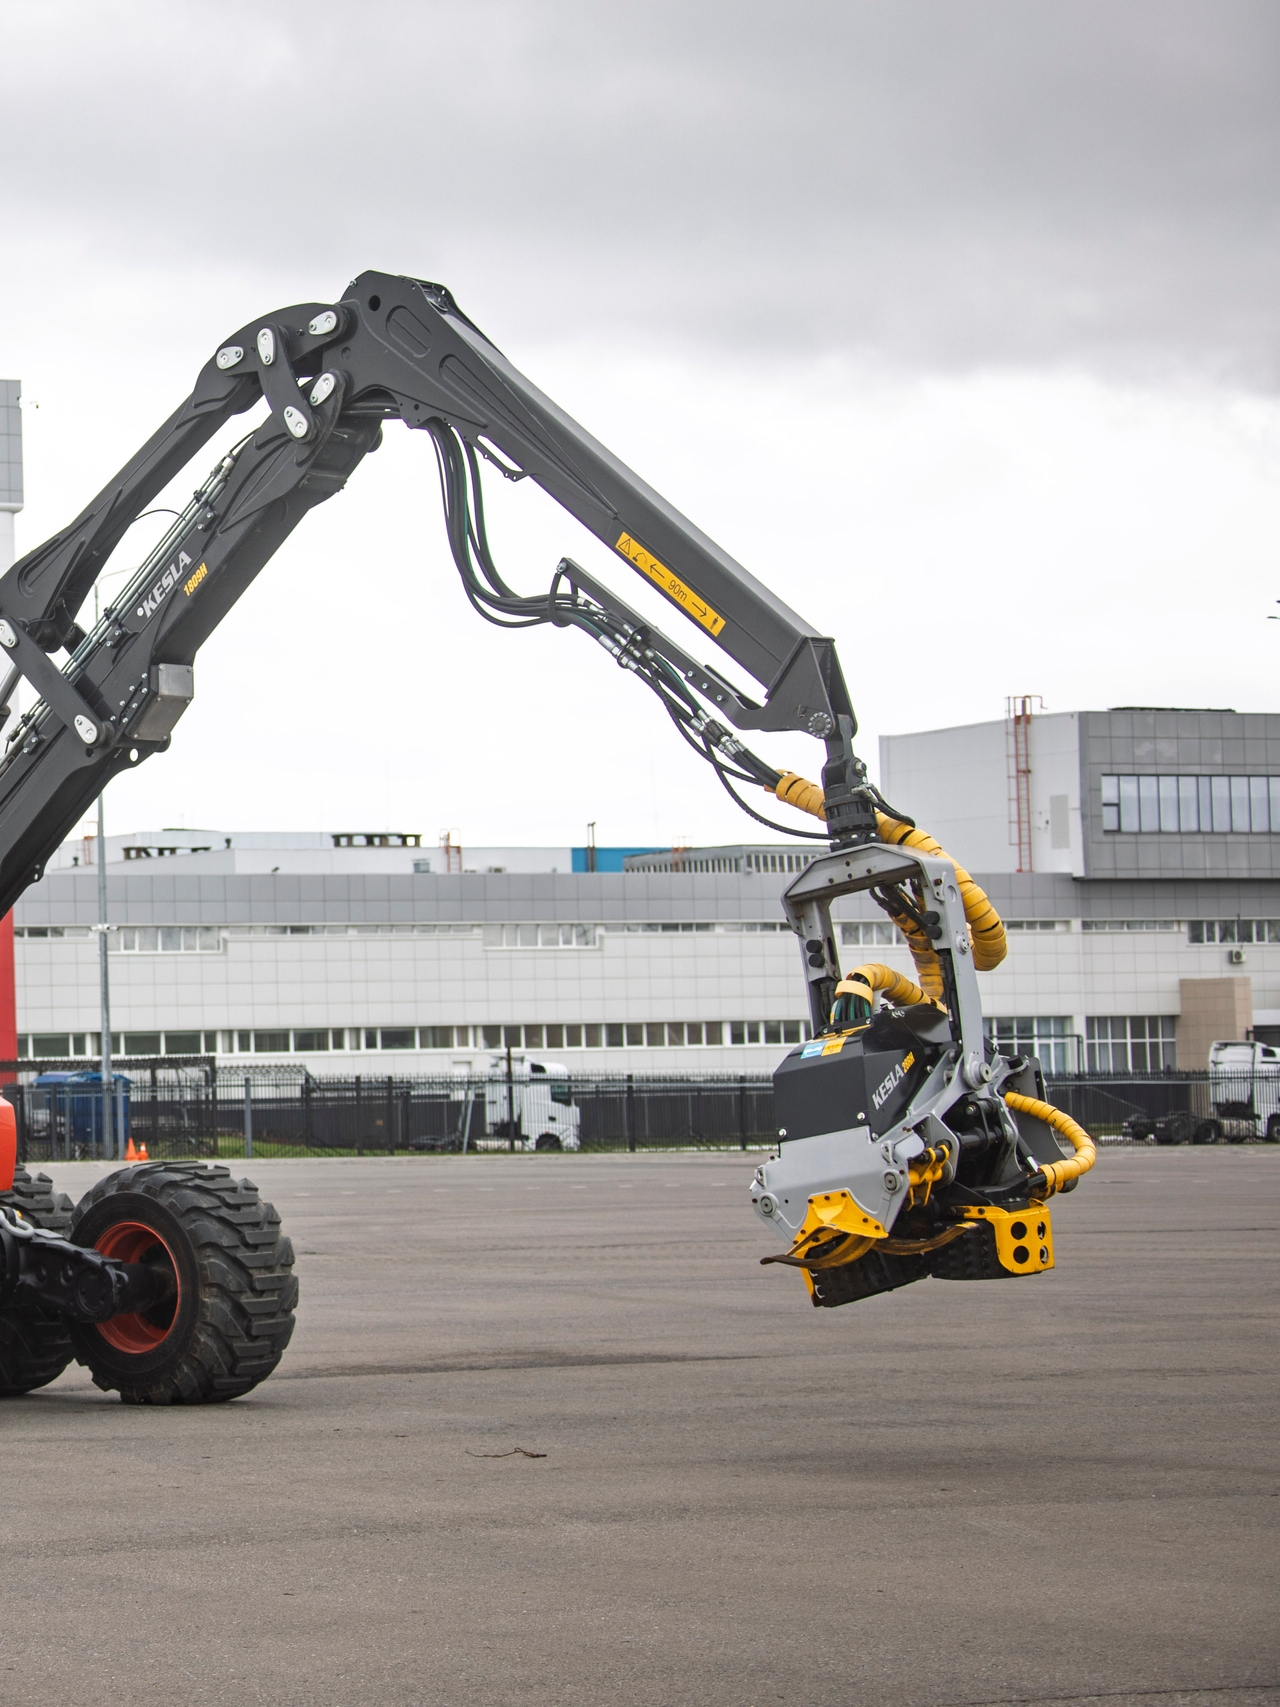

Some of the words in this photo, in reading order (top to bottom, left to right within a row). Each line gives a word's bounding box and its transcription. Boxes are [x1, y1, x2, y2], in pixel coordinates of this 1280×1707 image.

[142, 550, 193, 618] KESLA
[183, 562, 208, 596] 1809H
[667, 579, 688, 602] 90m
[871, 1063, 905, 1110] KESLA
